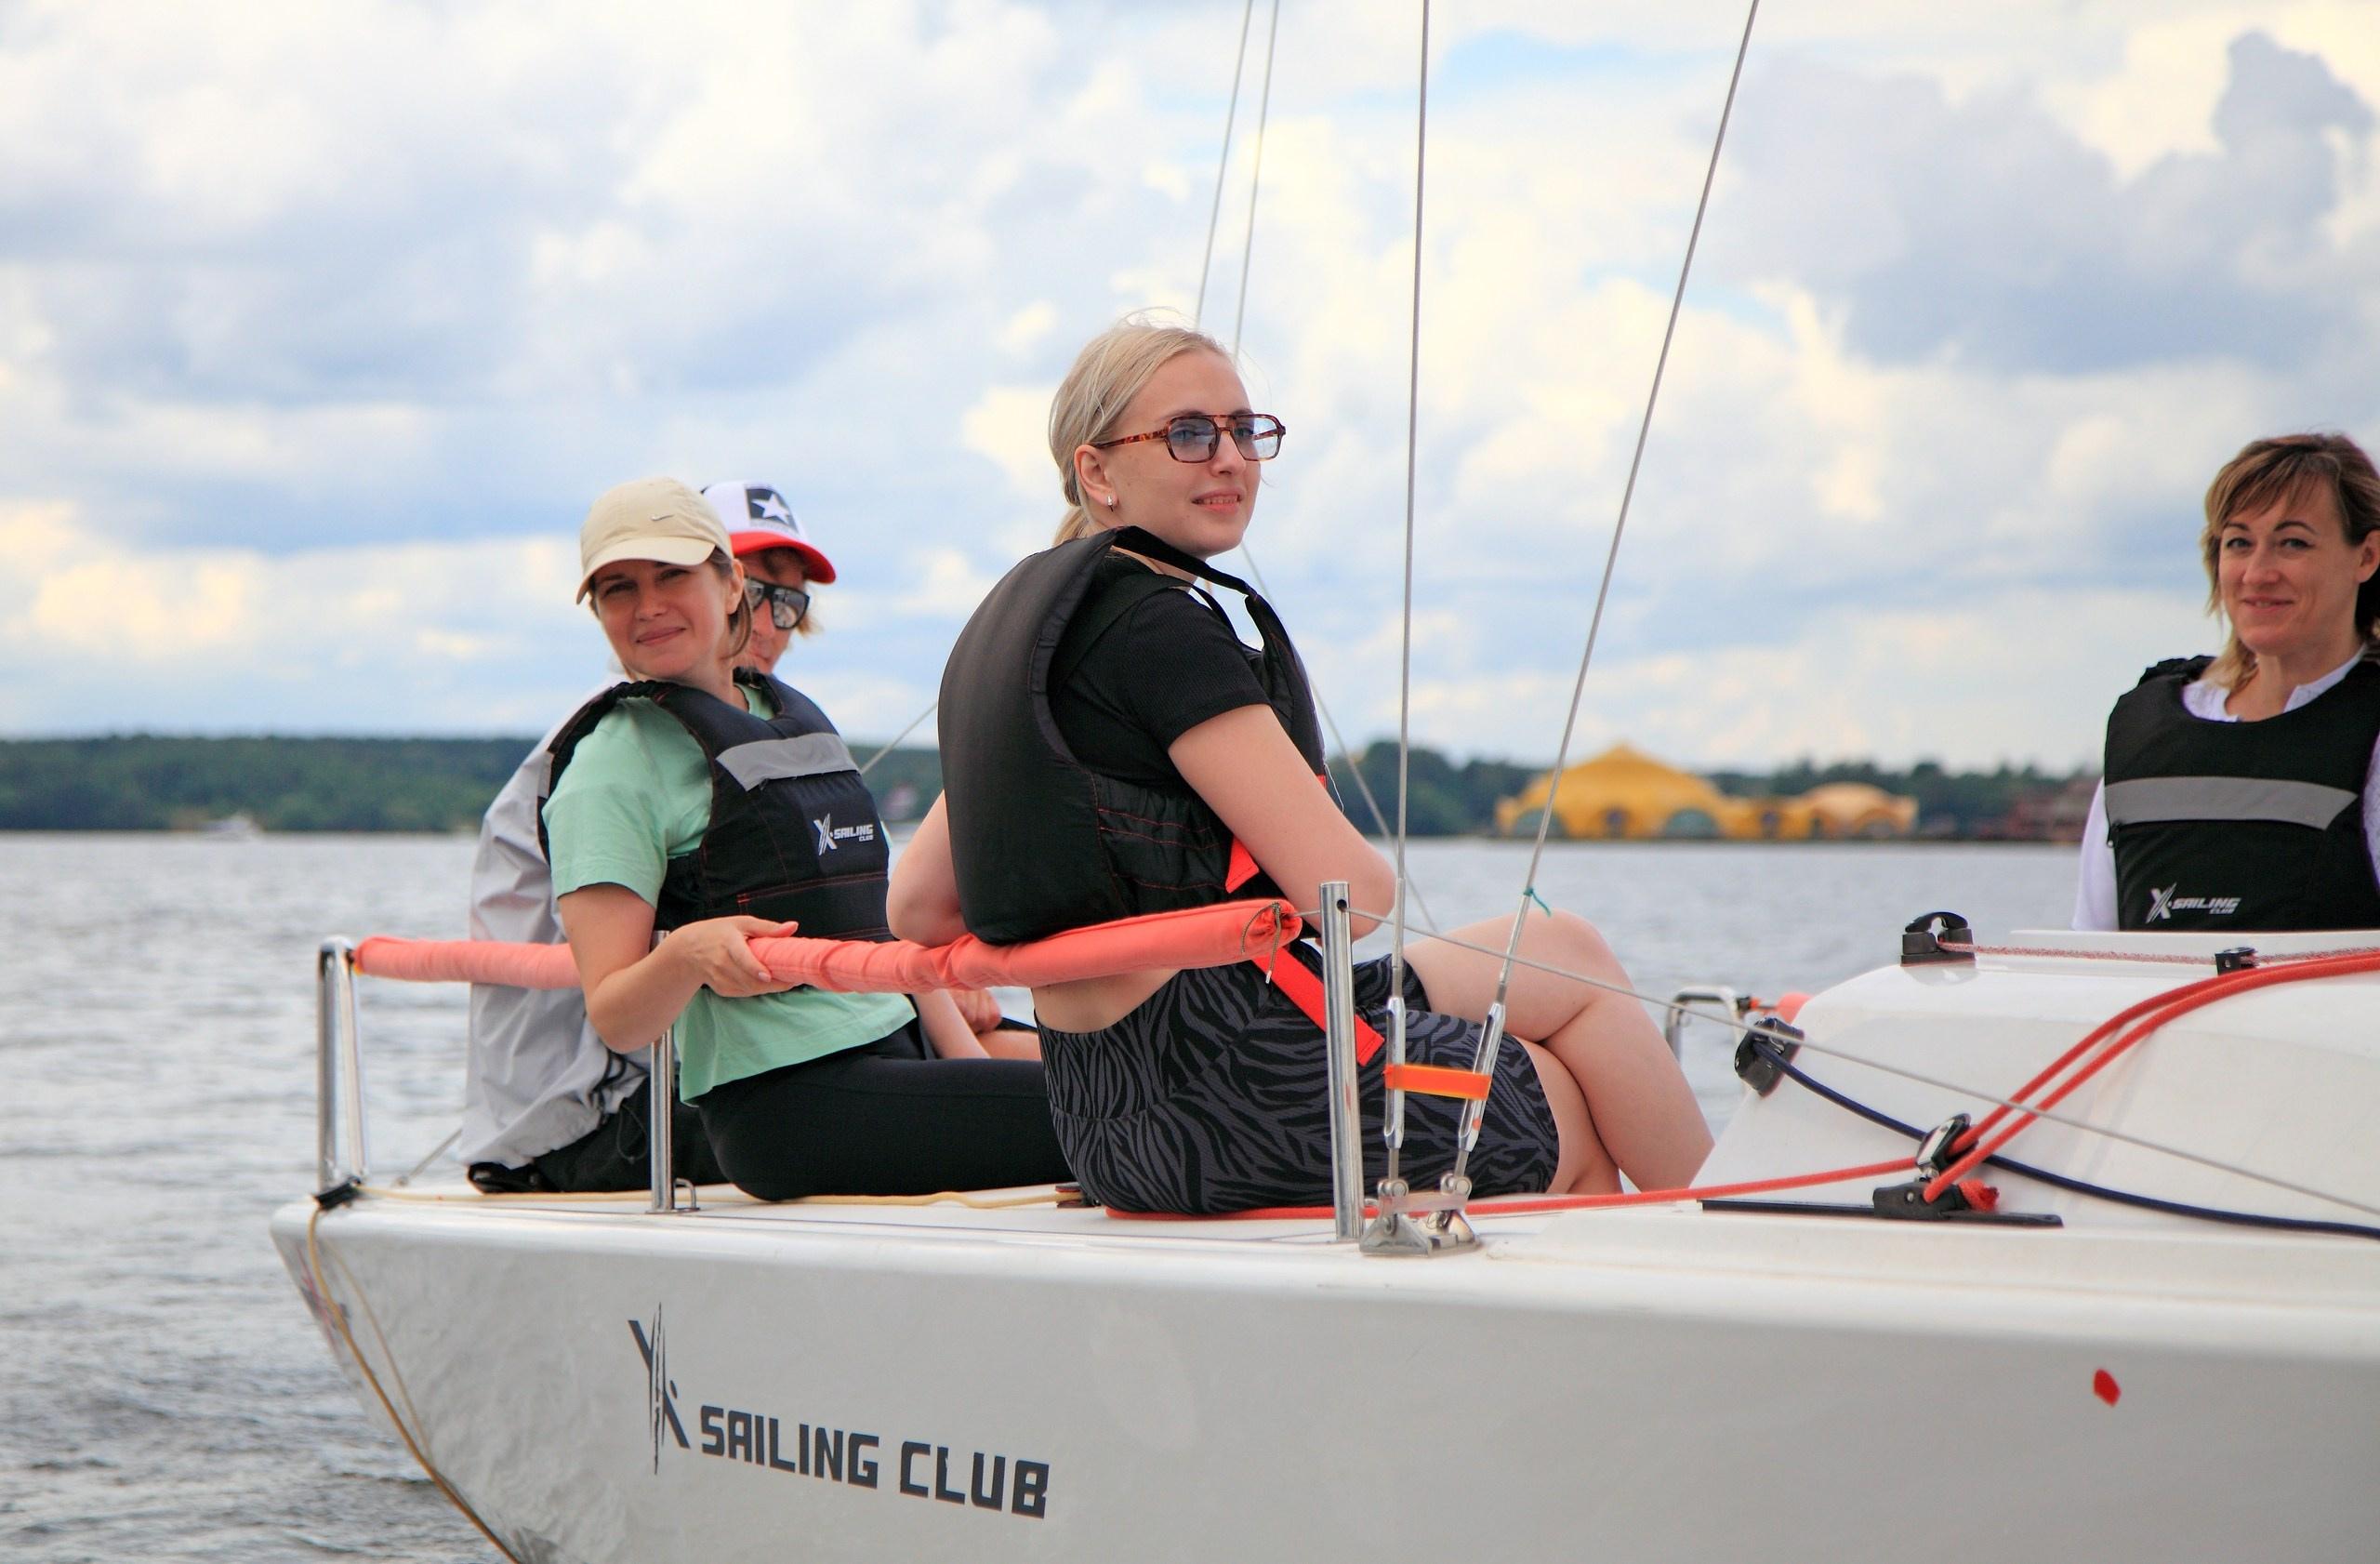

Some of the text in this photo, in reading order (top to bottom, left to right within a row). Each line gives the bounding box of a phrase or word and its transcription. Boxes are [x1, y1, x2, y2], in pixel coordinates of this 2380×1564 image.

[833, 824, 874, 840] SAILING
[2171, 897, 2241, 909] SAILING
[700, 1404, 879, 1489] SAILING
[899, 1440, 1050, 1519] CLUB
